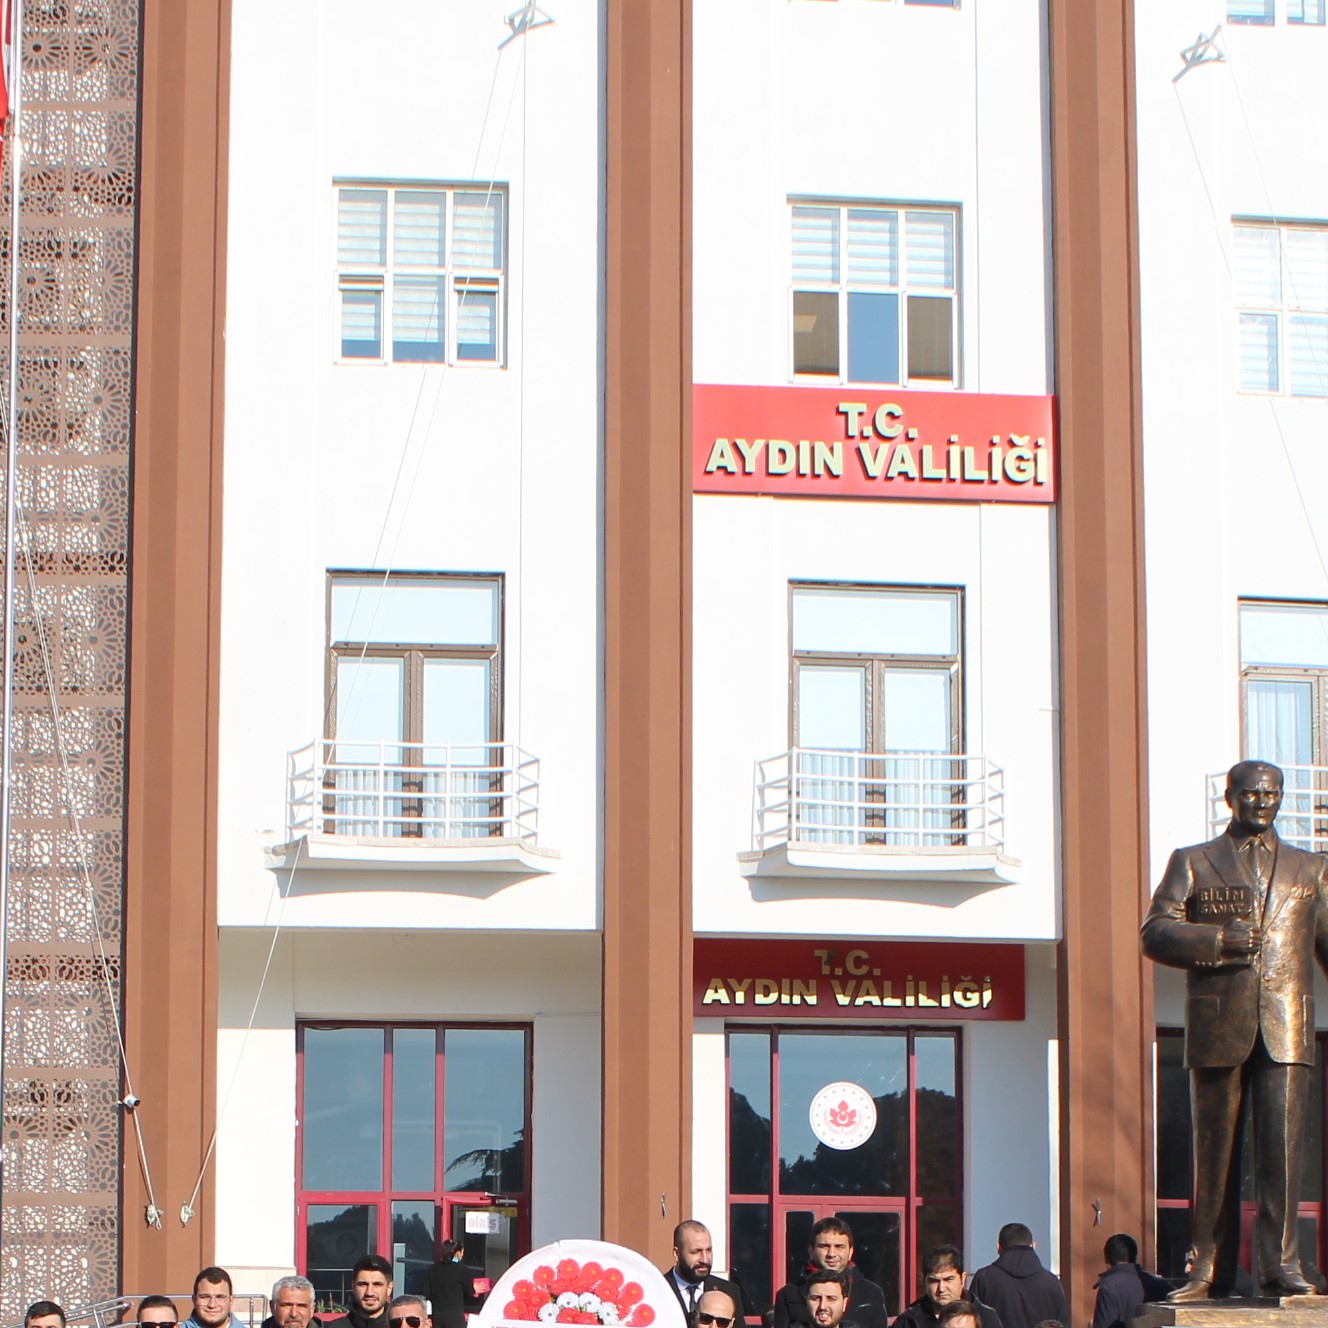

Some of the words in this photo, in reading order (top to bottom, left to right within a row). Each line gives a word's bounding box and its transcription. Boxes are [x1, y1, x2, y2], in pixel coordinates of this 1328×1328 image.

[838, 402, 918, 438] T.C.
[706, 438, 843, 477] AYDIN
[856, 433, 1046, 483] VALİLİĞİ
[814, 949, 881, 976] T.C.
[702, 978, 818, 1006] AYDIN
[831, 974, 993, 1008] VALİLİĞİ
